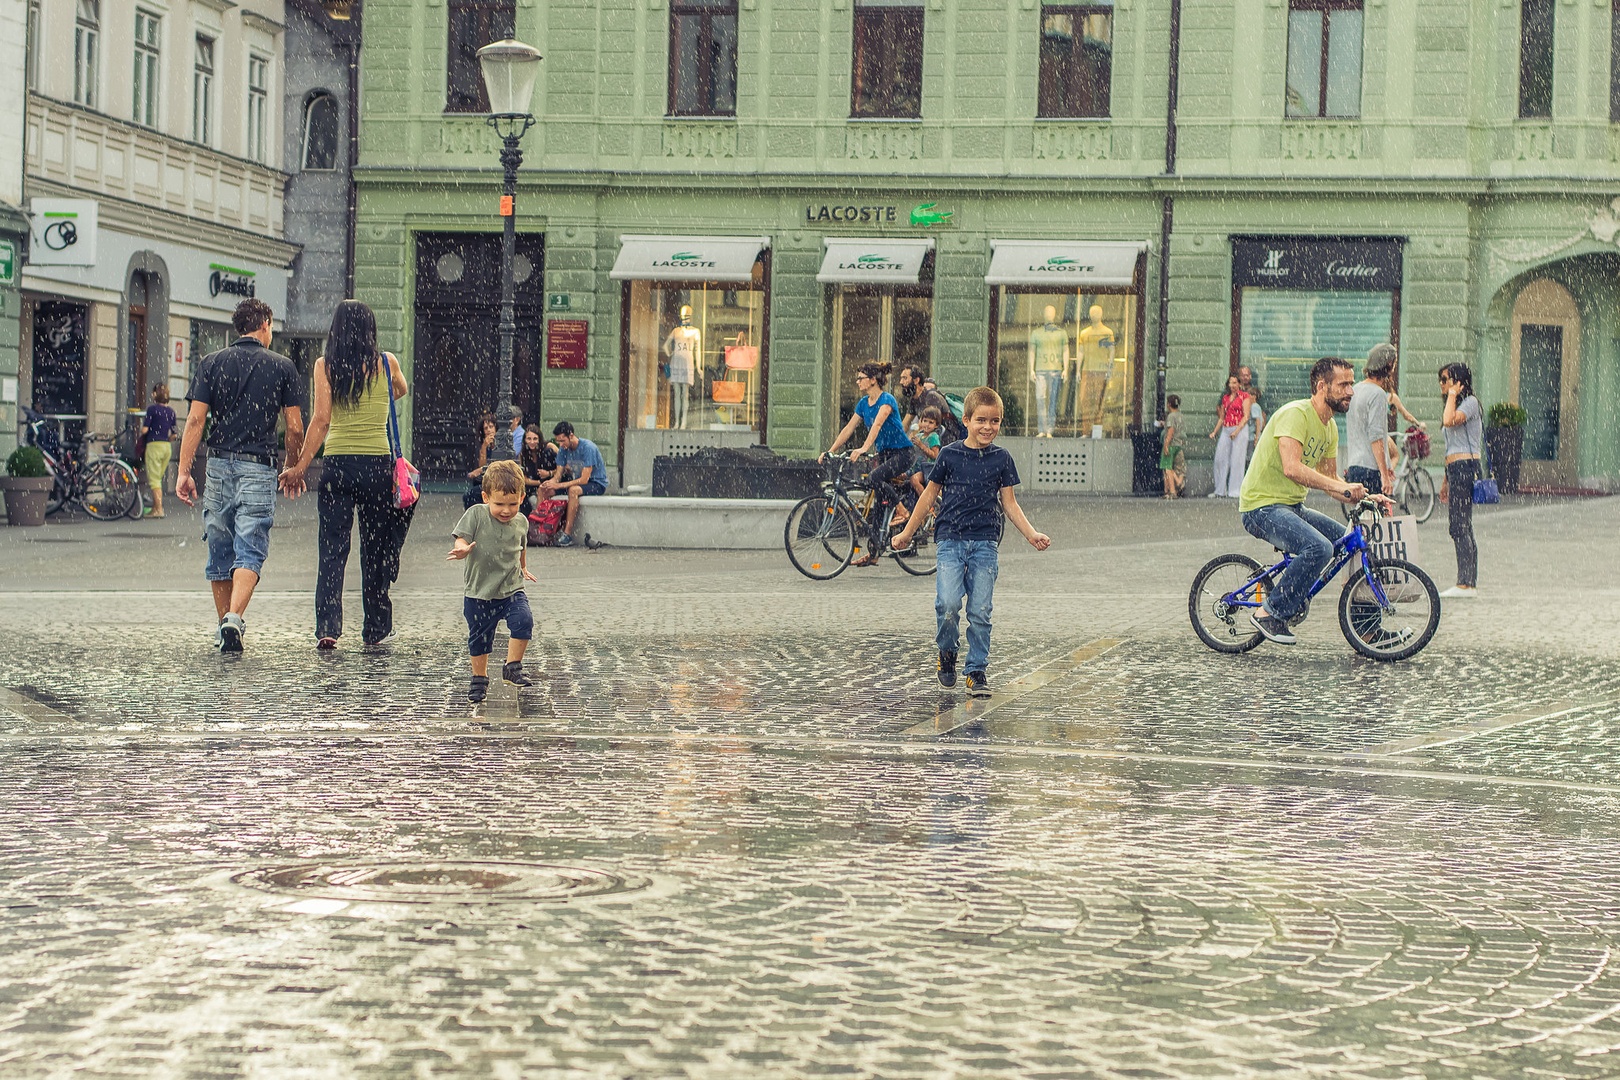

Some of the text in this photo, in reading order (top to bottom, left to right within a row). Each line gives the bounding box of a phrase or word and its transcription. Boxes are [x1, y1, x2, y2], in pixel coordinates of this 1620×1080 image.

[806, 205, 896, 221] LACOSTE
[652, 260, 717, 268] LACOSTE
[838, 263, 904, 271] LACOSTE
[1326, 260, 1380, 277] Cartier
[1257, 267, 1290, 276] HUBLOT
[556, 295, 562, 305] 3
[1387, 520, 1402, 541] IT
